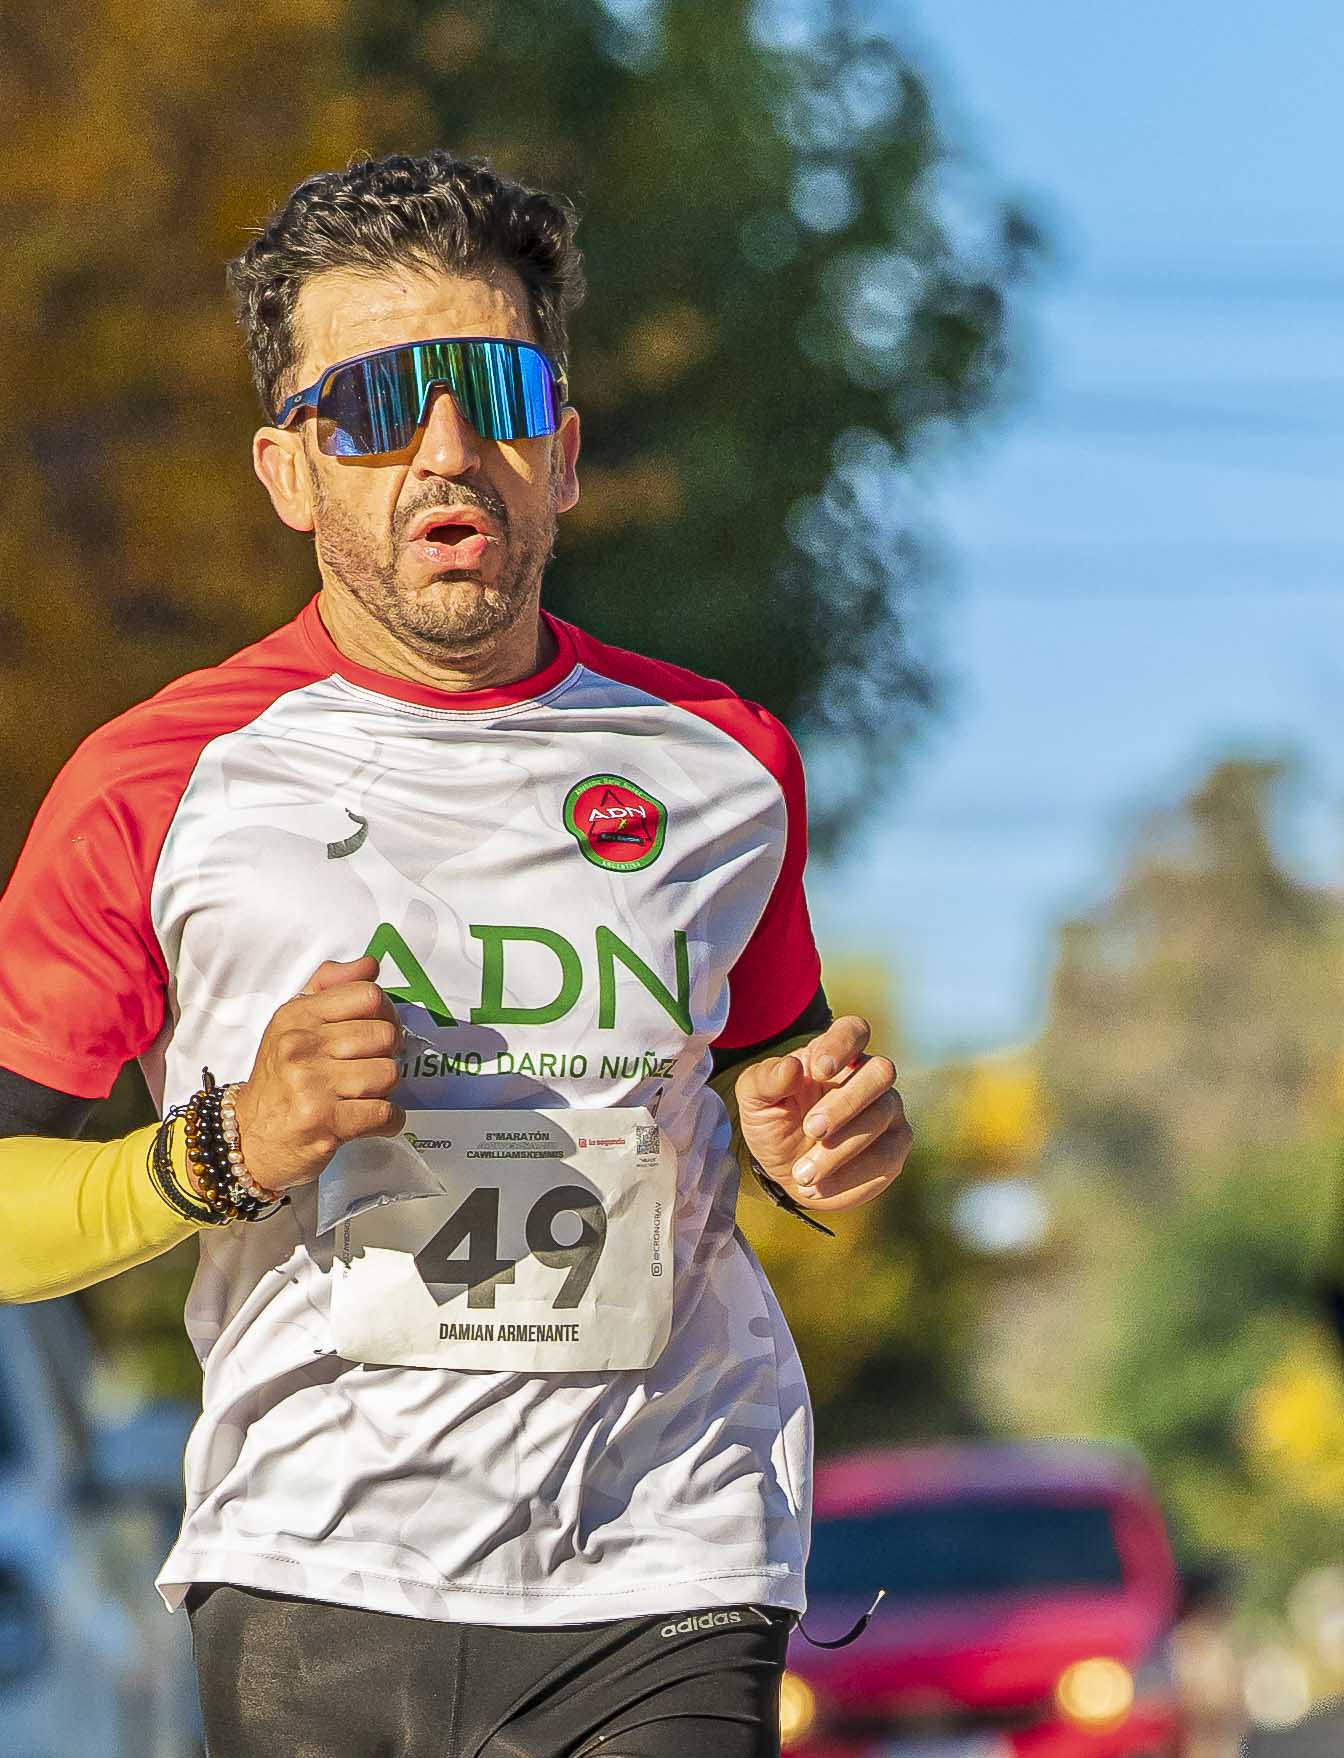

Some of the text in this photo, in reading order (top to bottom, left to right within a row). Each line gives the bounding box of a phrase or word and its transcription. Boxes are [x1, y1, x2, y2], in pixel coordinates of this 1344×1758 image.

[588, 805, 647, 822] ADN
[364, 922, 694, 1036] ADN
[496, 1051, 588, 1079] DARIO
[599, 1051, 679, 1080] NUÑEZ
[414, 1185, 608, 1310] 49
[439, 1322, 581, 1343] DAMIAN ARMENANTE
[660, 1611, 743, 1638] adidas
